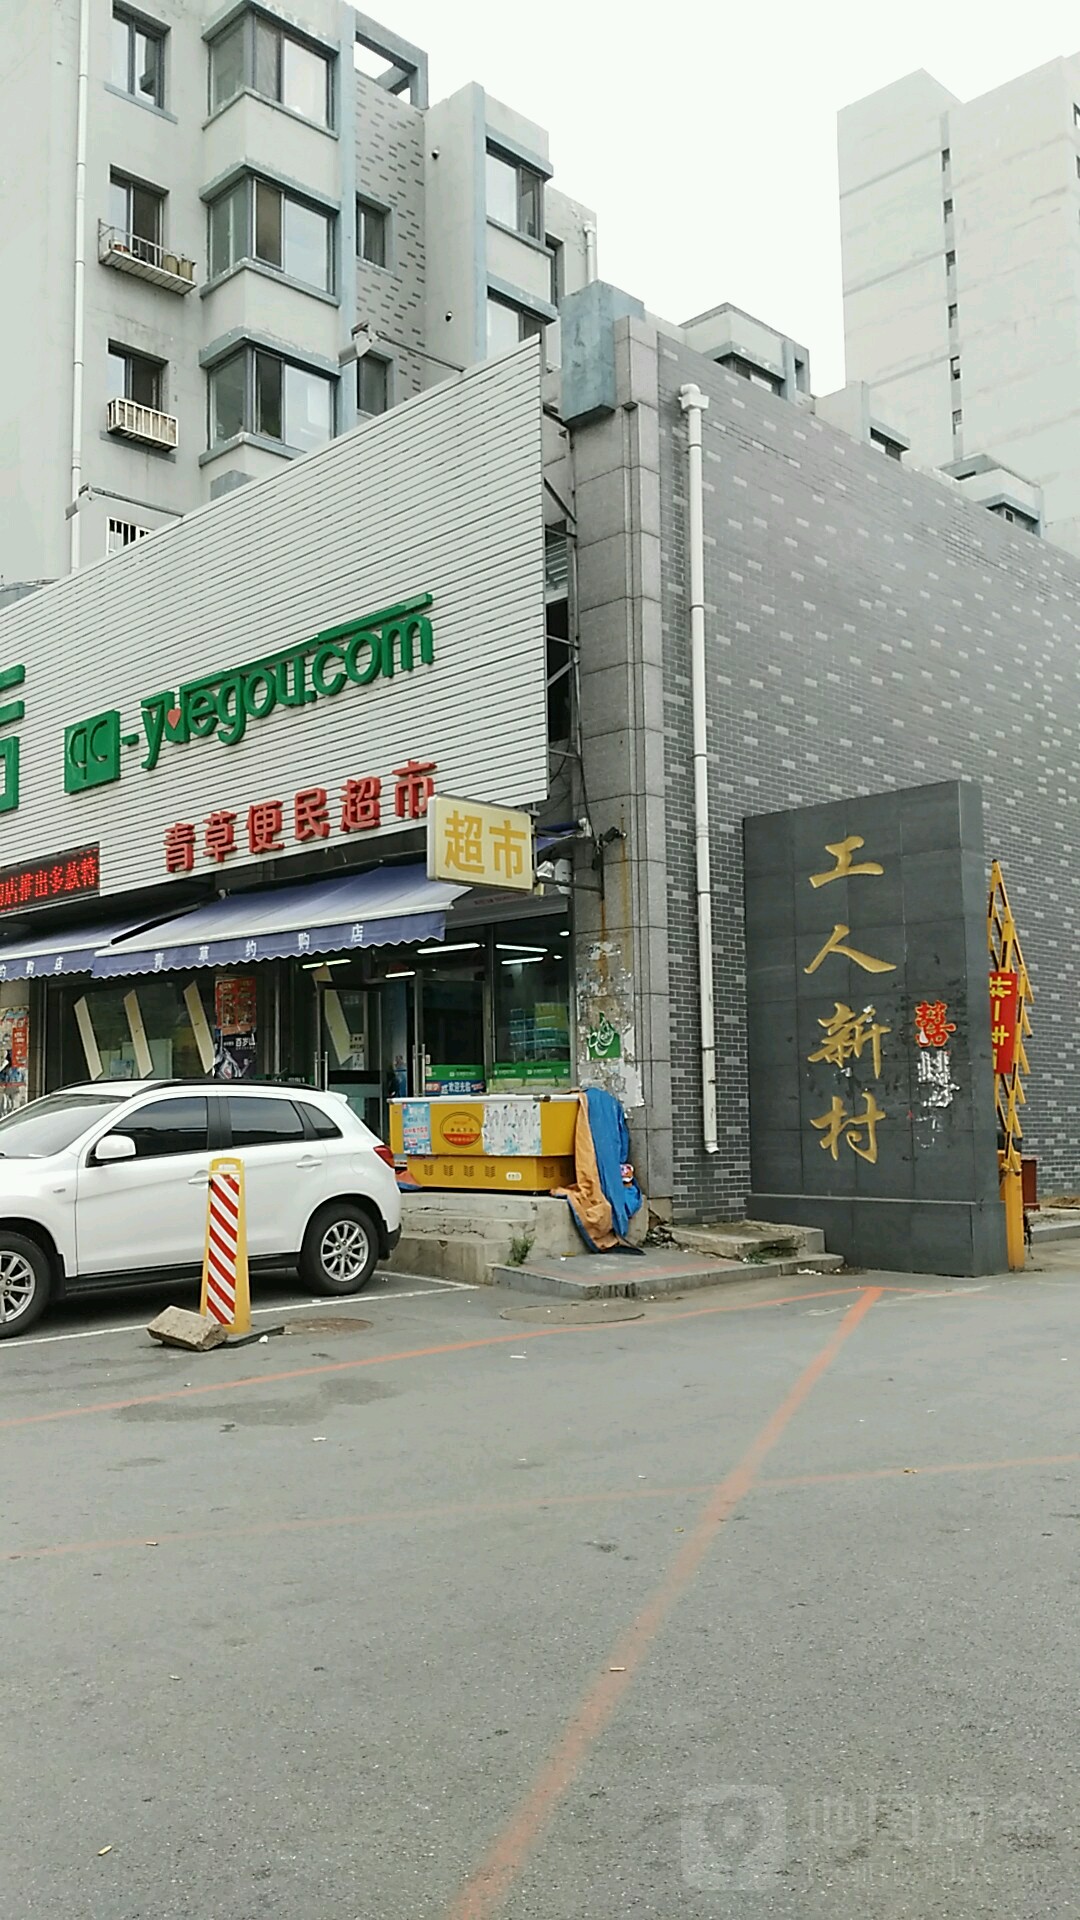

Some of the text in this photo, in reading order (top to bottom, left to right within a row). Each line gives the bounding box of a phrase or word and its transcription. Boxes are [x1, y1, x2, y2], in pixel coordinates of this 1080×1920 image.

[164, 760, 437, 872] 青草便民超市
[444, 810, 527, 879] 超市
[154, 923, 364, 969] 青草约购店
[804, 835, 897, 1165] 工人新村
